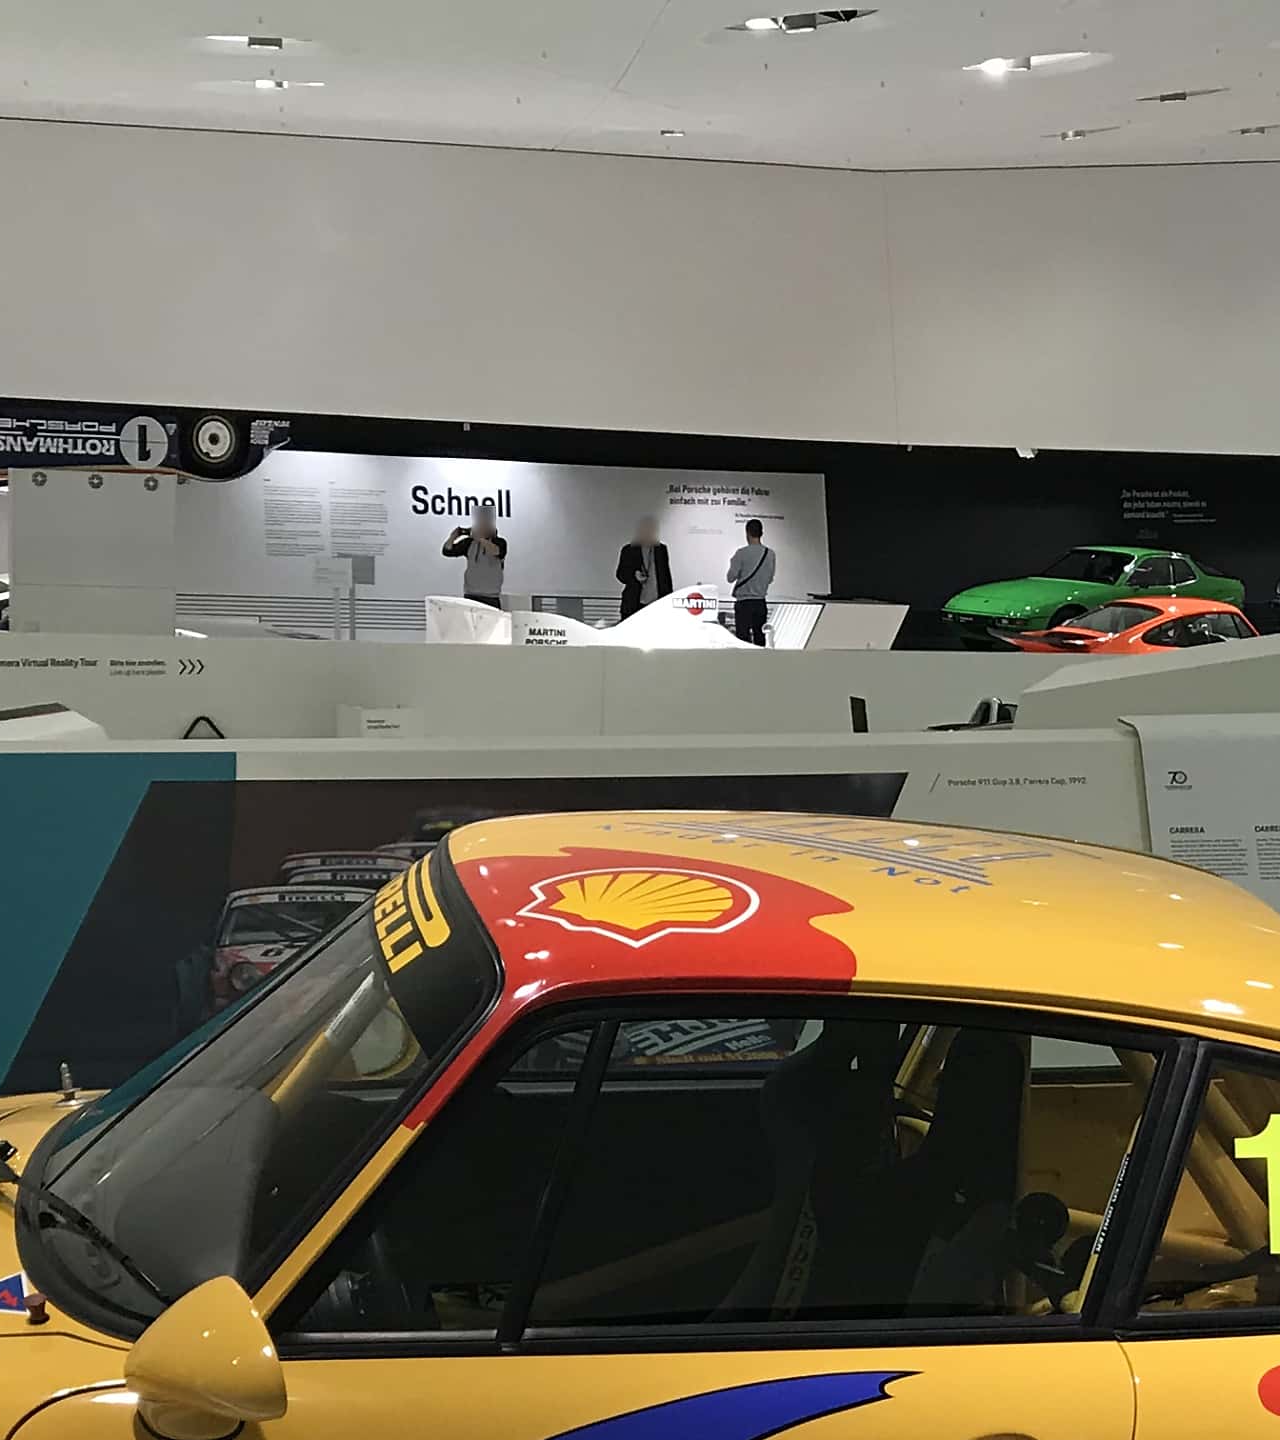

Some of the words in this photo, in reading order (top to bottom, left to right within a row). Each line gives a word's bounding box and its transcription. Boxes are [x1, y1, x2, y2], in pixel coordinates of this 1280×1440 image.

[136, 424, 152, 462] 1
[673, 597, 717, 609] MARTINI
[528, 628, 566, 637] MARTINI
[21, 658, 49, 667] Virtual
[50, 658, 79, 669] Reality
[79, 658, 99, 667] Tour
